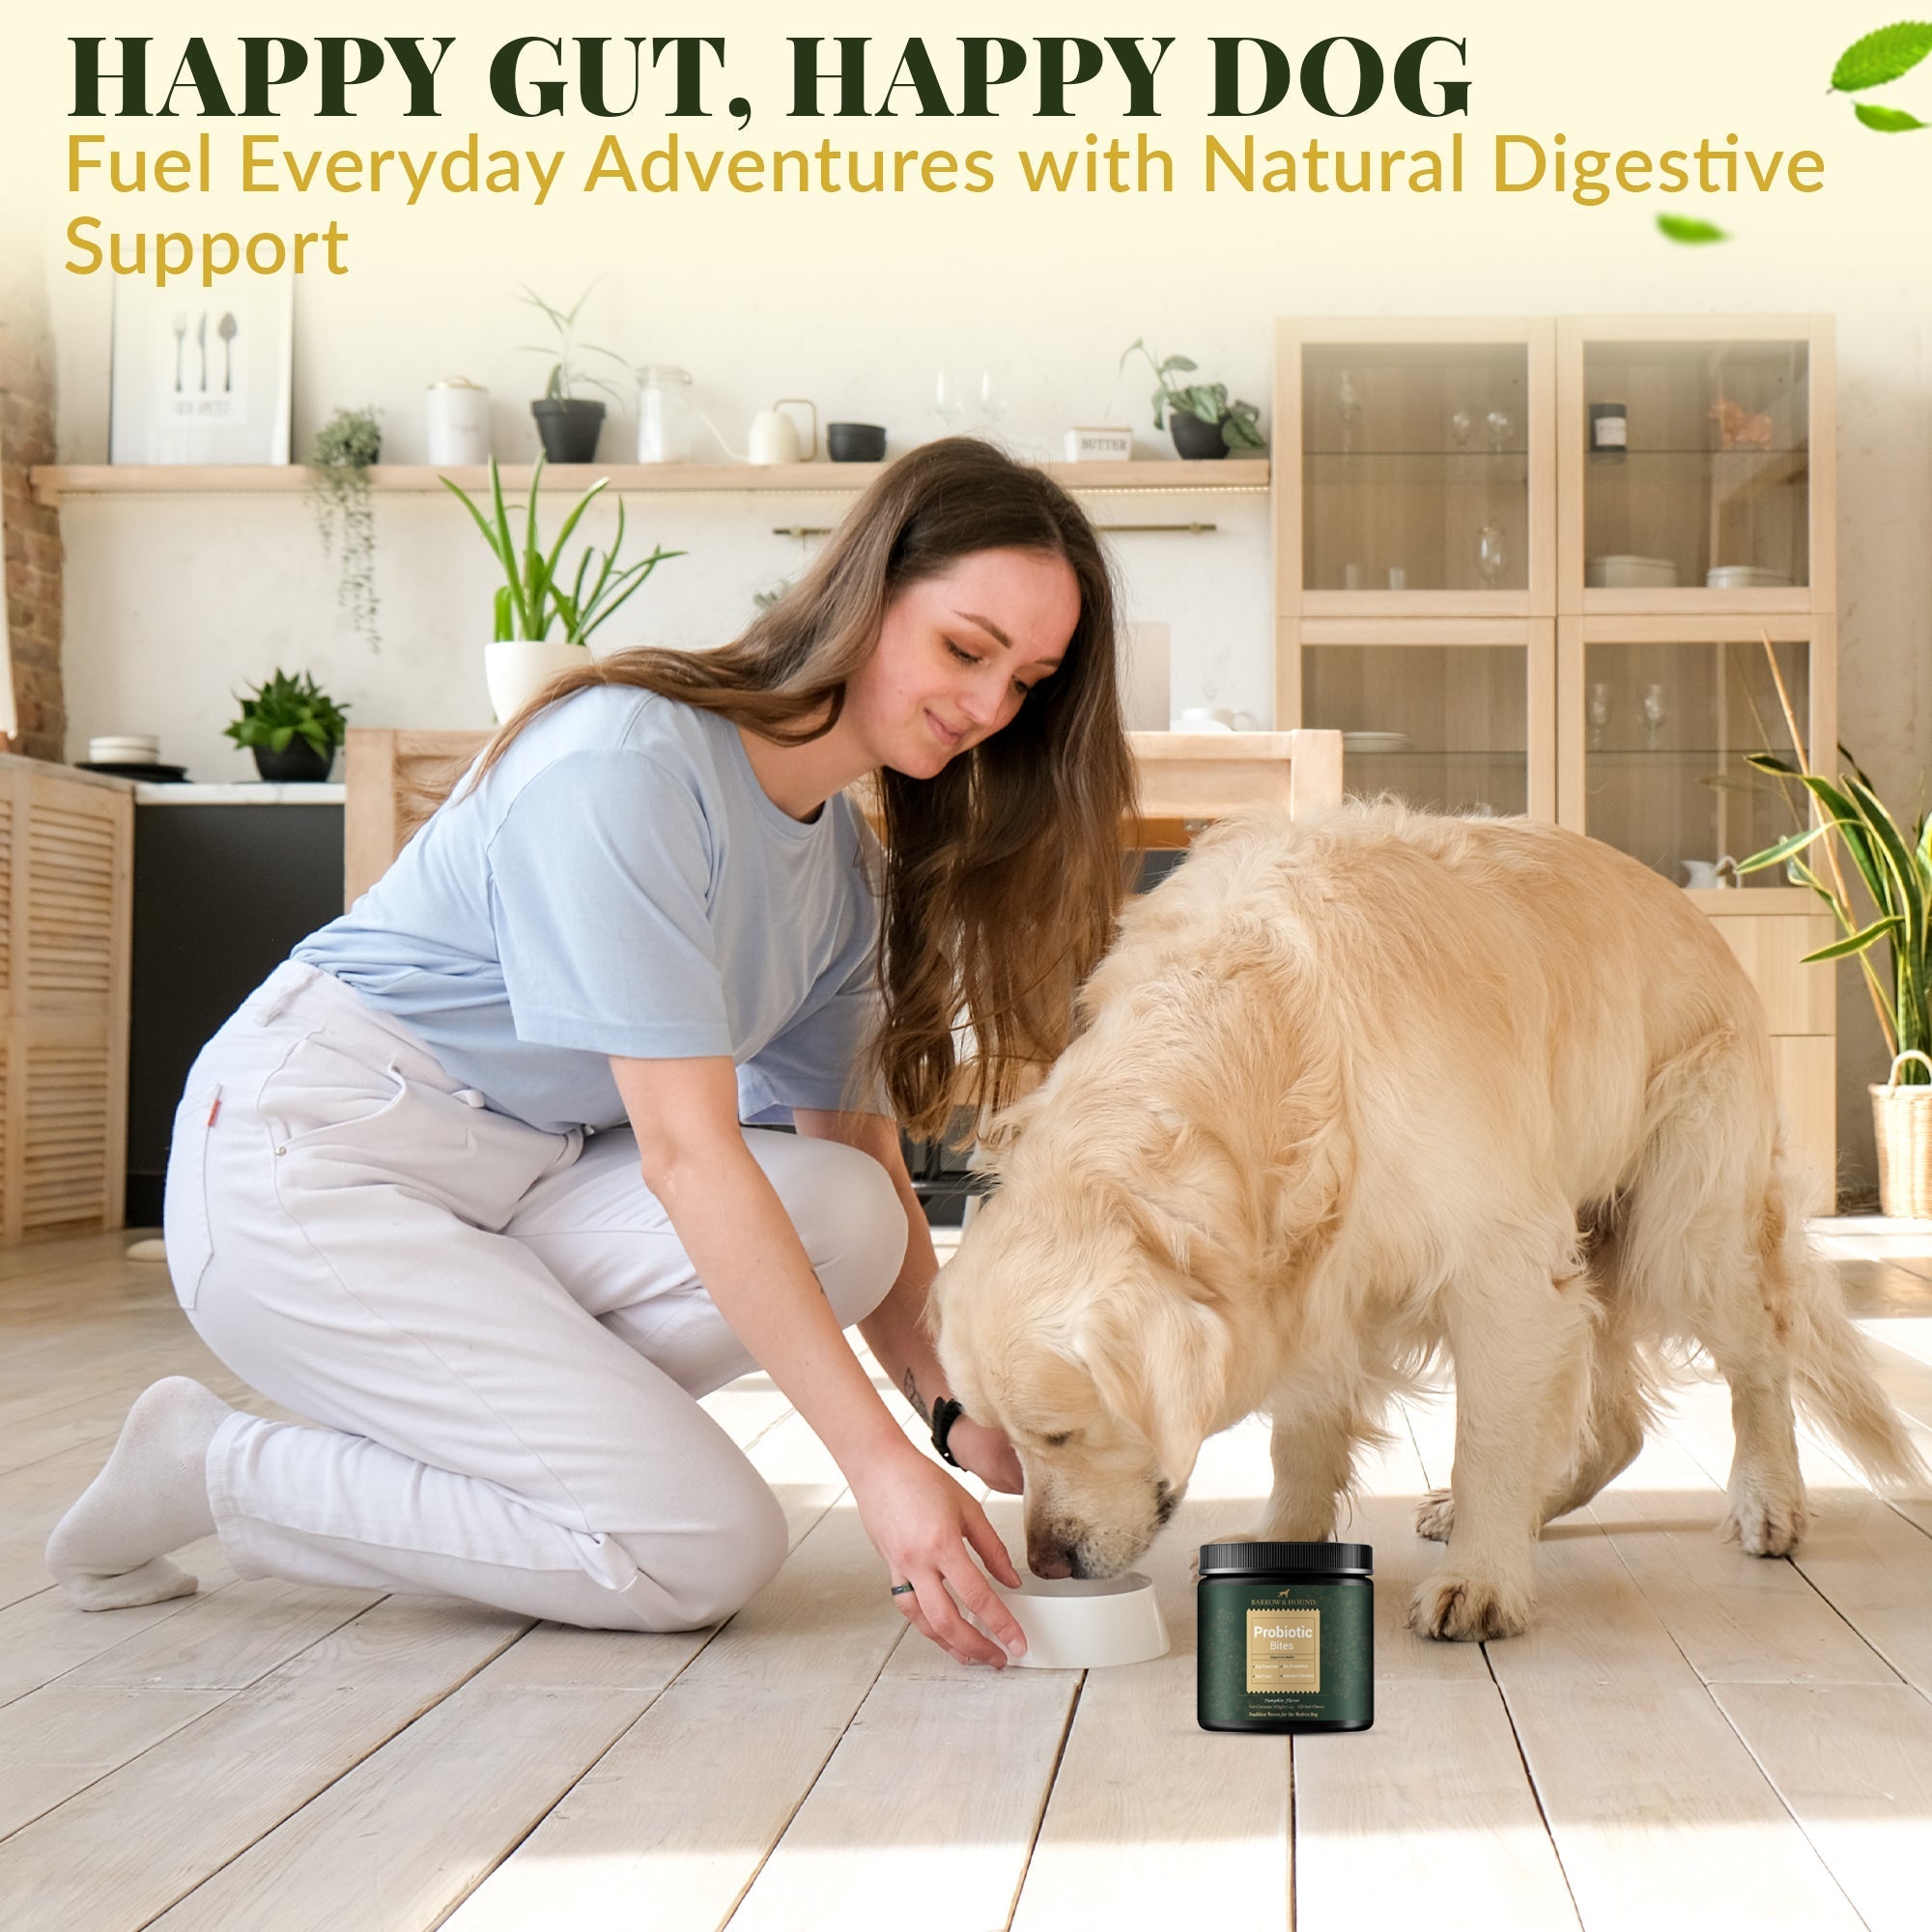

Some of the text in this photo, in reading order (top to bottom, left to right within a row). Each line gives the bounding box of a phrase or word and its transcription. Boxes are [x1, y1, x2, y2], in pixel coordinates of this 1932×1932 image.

[1081, 437, 1127, 450] BUTTER
[1253, 1625, 1314, 1638] Probiotic
[1269, 1641, 1294, 1651] Bites
